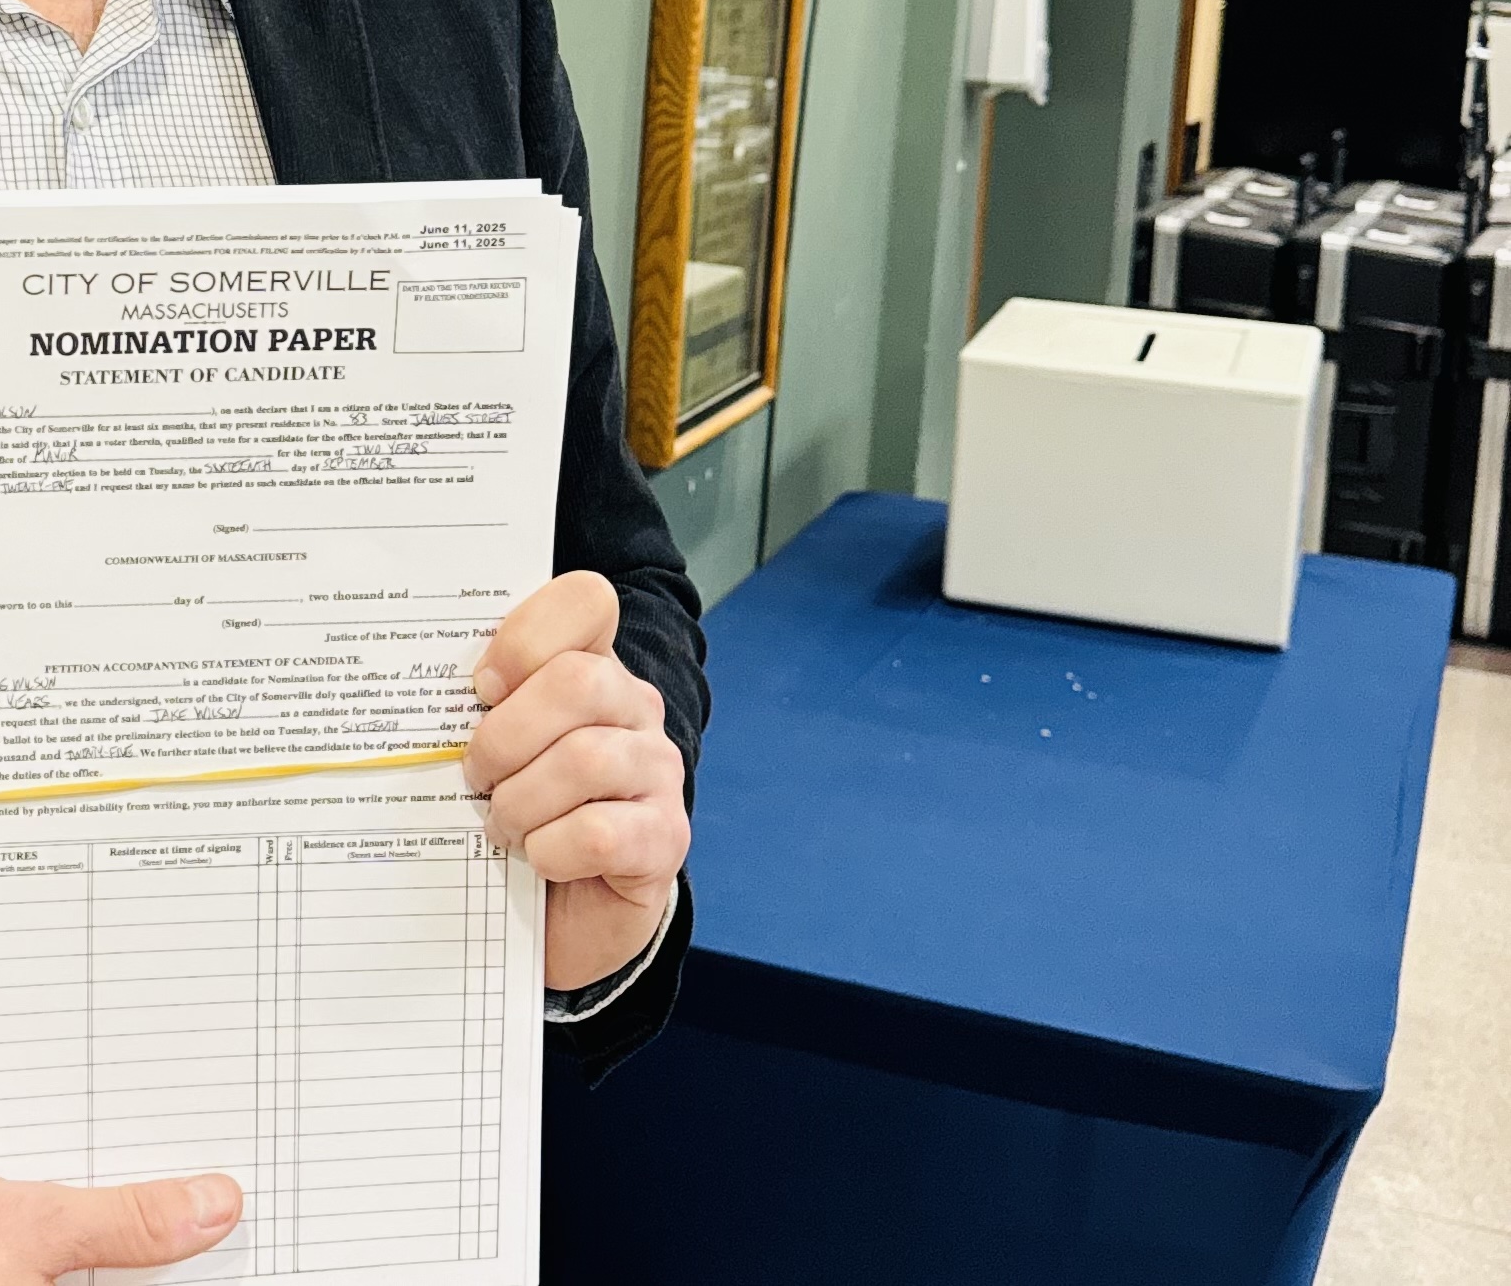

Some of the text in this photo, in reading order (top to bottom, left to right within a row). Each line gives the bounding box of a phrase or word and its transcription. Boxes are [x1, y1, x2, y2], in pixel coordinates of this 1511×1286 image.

[419, 223, 506, 236] June 11, 2025
[419, 238, 506, 250] June 11, 2025
[23, 273, 99, 295] CITY
[112, 273, 157, 294] OF
[170, 270, 390, 293] SOMERVILLE
[121, 302, 288, 320] MASSACHUSETTS
[30, 328, 376, 356] NOMINATION PAPER
[60, 366, 345, 385] STATEMENT OF CANDIDATE
[465, 411, 516, 425] STREET
[34, 444, 79, 463] MAYOR
[352, 441, 430, 456] TWO YEARS
[213, 524, 249, 534] (Signed)
[105, 555, 198, 565] COMMONWEALTH
[218, 552, 307, 562] MASSACHUSETTS
[174, 596, 205, 607] day of
[333, 589, 384, 600] thousand
[388, 589, 408, 598] and
[55, 600, 72, 608] this
[222, 619, 261, 629] (Signed)
[324, 633, 358, 642] Justice
[360, 632, 370, 641] of
[373, 632, 387, 640] the
[437, 630, 469, 639] Notary
[45, 656, 363, 673] PETITION ACCOMPANYING STATEMENT OF CANDIDATE.
[183, 678, 190, 686] is
[202, 677, 247, 686] candidate
[251, 676, 265, 684] for
[268, 674, 324, 683] Nomination
[345, 673, 359, 681] the
[362, 672, 387, 681] office
[390, 672, 401, 680] of
[81, 698, 96, 706] the
[99, 696, 161, 707] undersigned,
[196, 695, 206, 703] of
[209, 694, 223, 702] the
[226, 693, 247, 703] City
[249, 693, 260, 701] of
[262, 691, 312, 701] Somerville
[315, 691, 336, 700] duly
[340, 689, 381, 700] qualified
[420, 688, 433, 696] for
[445, 686, 476, 695] candid
[1, 718, 37, 728] request
[40, 717, 58, 725] that
[62, 717, 77, 725] the
[109, 715, 119, 723] of
[121, 714, 140, 723] said
[149, 708, 188, 722] JAKE
[12, 771, 41, 780] duties
[44, 770, 54, 779] of
[56, 770, 70, 778] the
[73, 769, 101, 777] office.
[110, 847, 157, 856] Residence
[172, 846, 192, 854] time
[195, 844, 205, 853] of
[207, 844, 241, 854] signing
[304, 840, 344, 849] Residence
[359, 839, 393, 848] January
[403, 838, 417, 846] last
[421, 838, 427, 846] if
[429, 837, 464, 845] different
[474, 834, 482, 857] Ward
[265, 840, 274, 864] Ward
